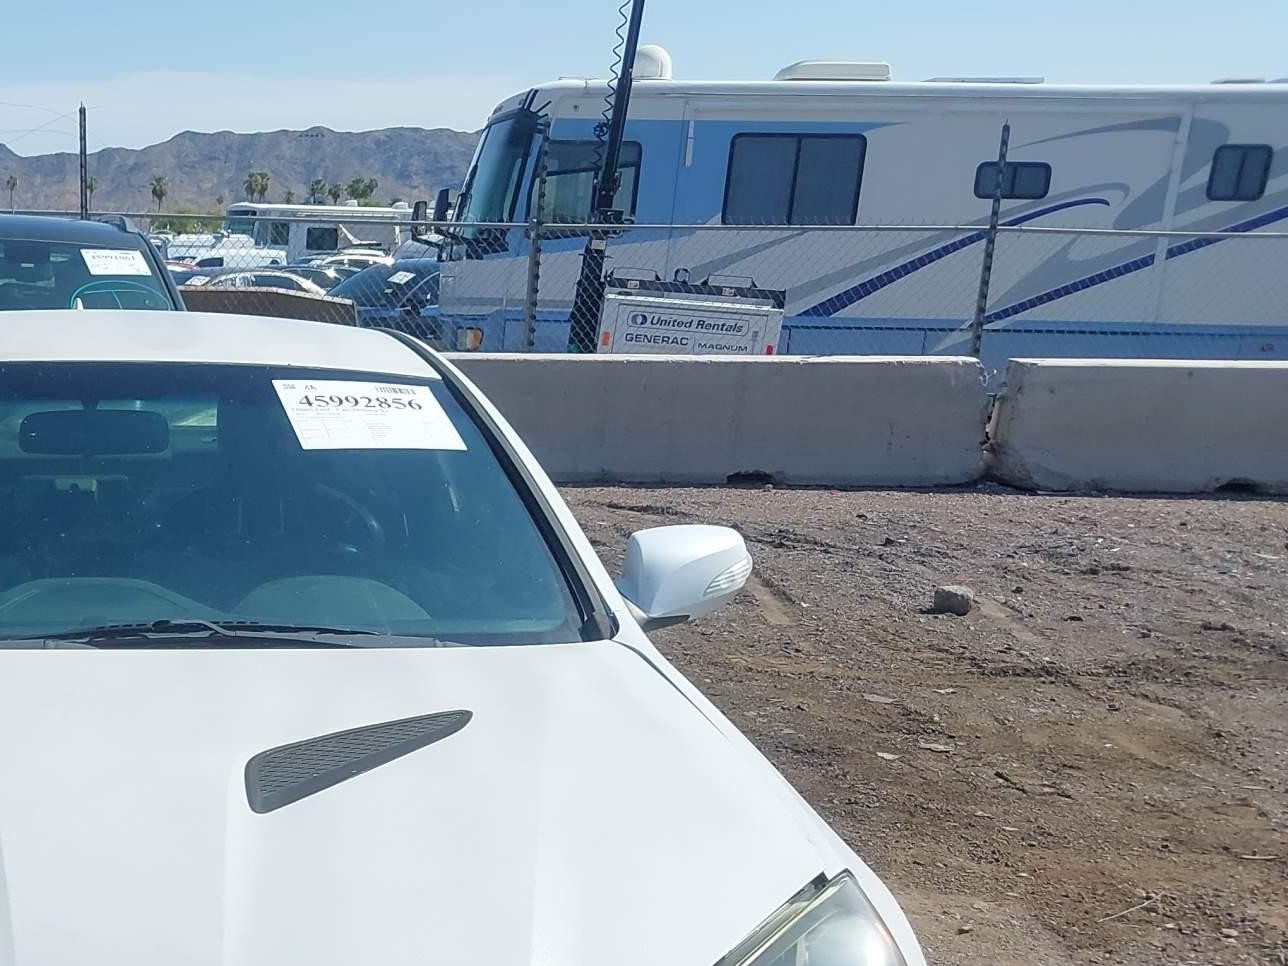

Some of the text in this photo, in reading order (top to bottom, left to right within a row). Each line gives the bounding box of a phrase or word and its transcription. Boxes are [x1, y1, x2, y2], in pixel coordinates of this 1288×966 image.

[650, 315, 744, 333] United Rentals
[625, 332, 748, 353] GENERAC MAGNUM
[298, 394, 423, 411] 45992856
